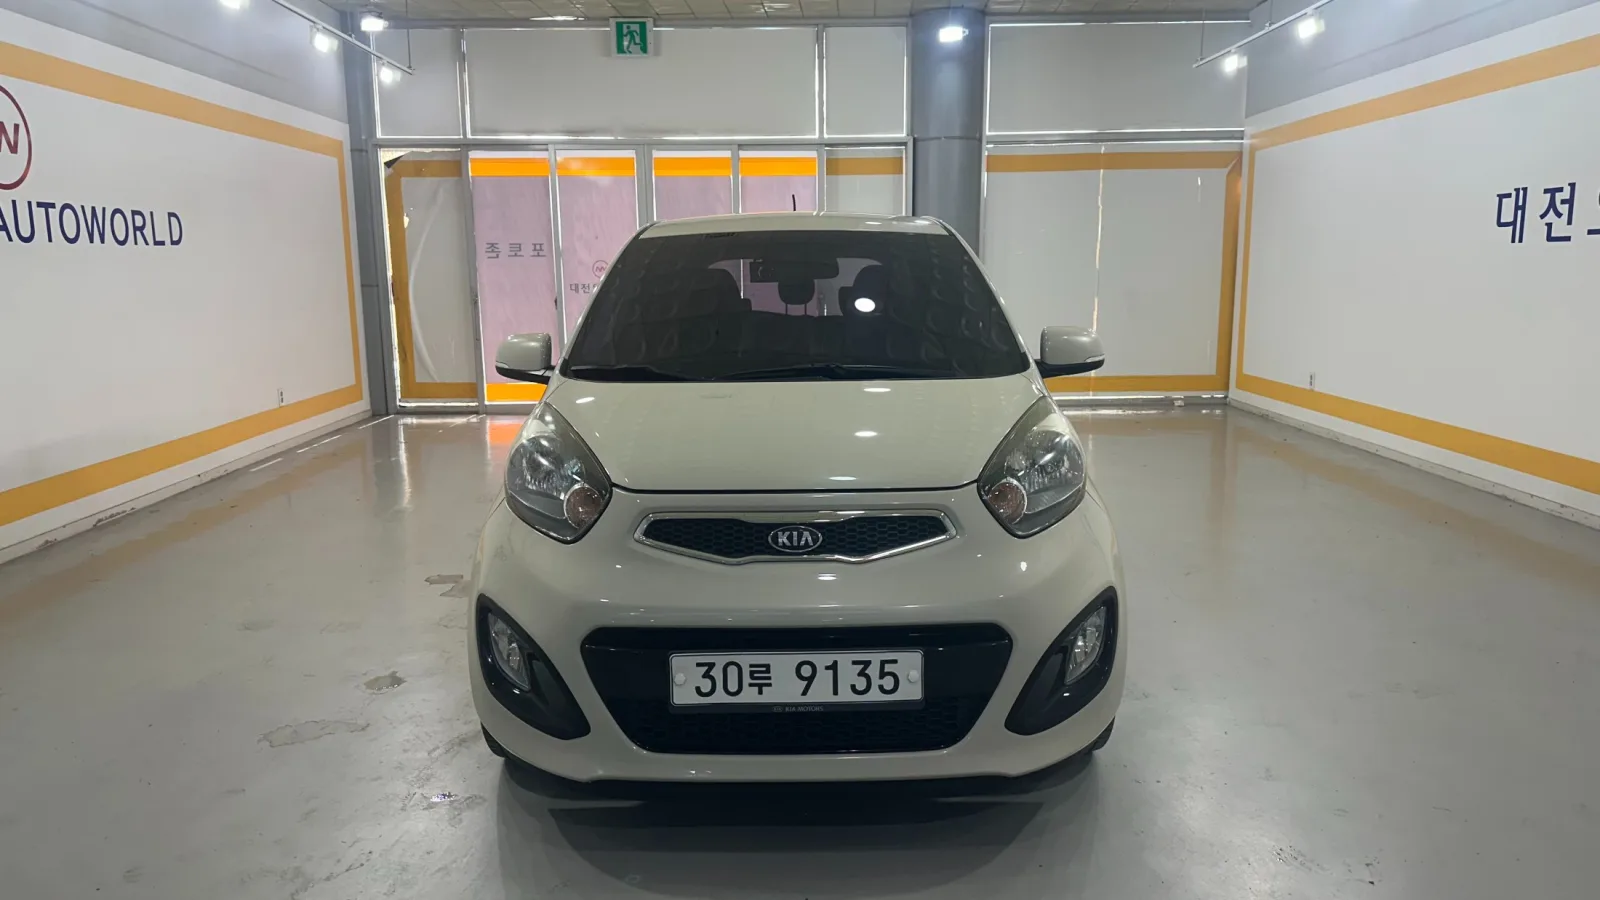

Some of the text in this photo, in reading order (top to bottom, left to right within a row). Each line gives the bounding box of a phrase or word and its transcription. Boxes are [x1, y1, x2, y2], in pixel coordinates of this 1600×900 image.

[1496, 182, 1600, 244] 대전
[777, 531, 814, 546] KIA
[695, 659, 900, 698] 30루 9135
